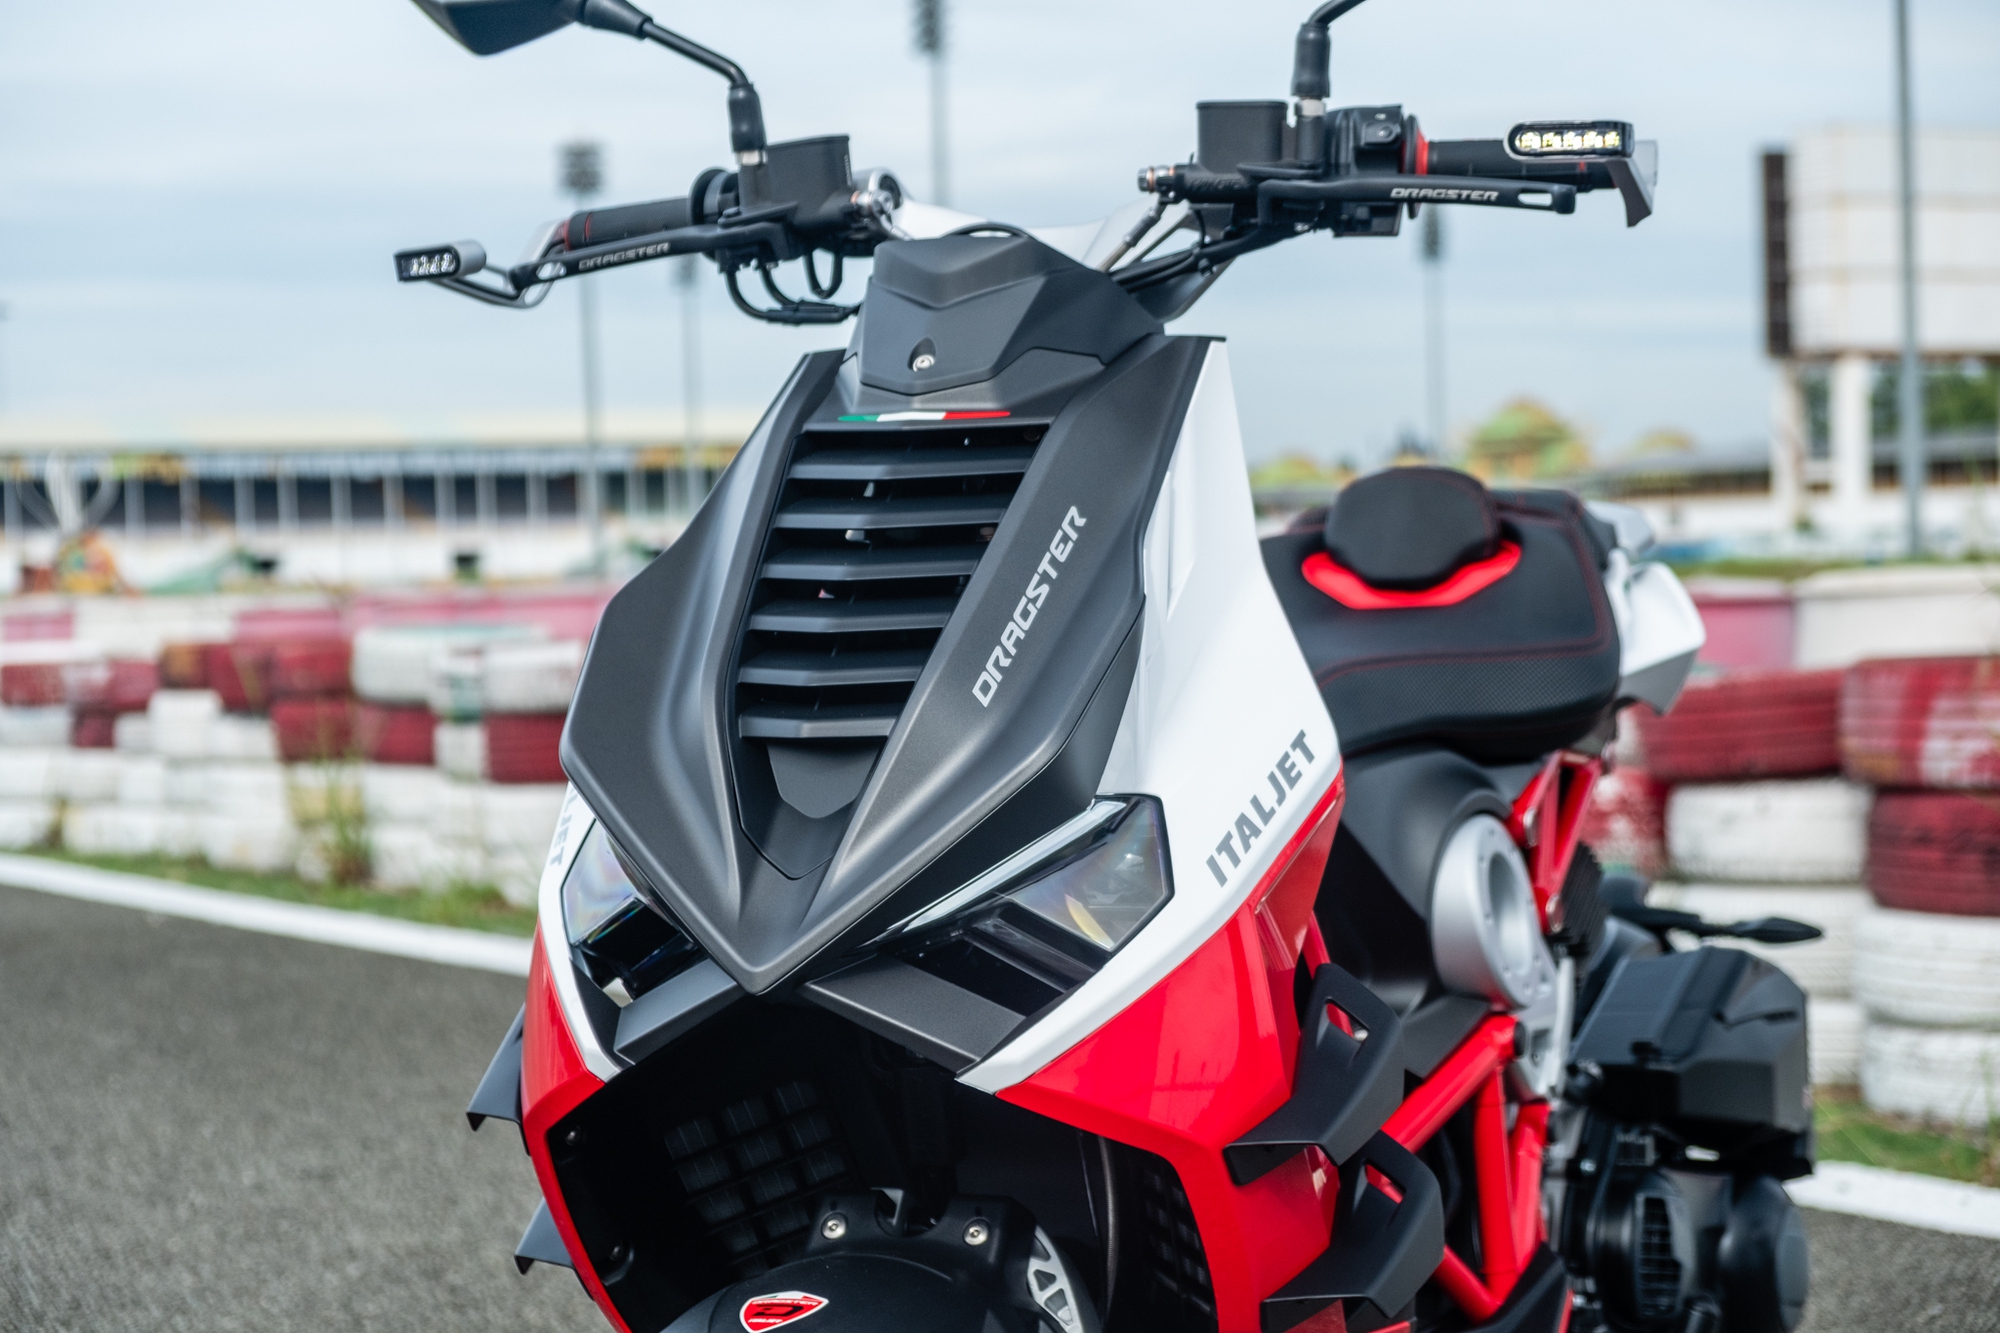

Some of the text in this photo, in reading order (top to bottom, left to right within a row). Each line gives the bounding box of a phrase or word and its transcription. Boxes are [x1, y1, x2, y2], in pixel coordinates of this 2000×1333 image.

[1390, 188, 1499, 201] DRAGSTER
[578, 242, 669, 271] DRAGSTER
[972, 505, 1087, 708] DRAGSTER
[1205, 729, 1315, 888] ITALJET
